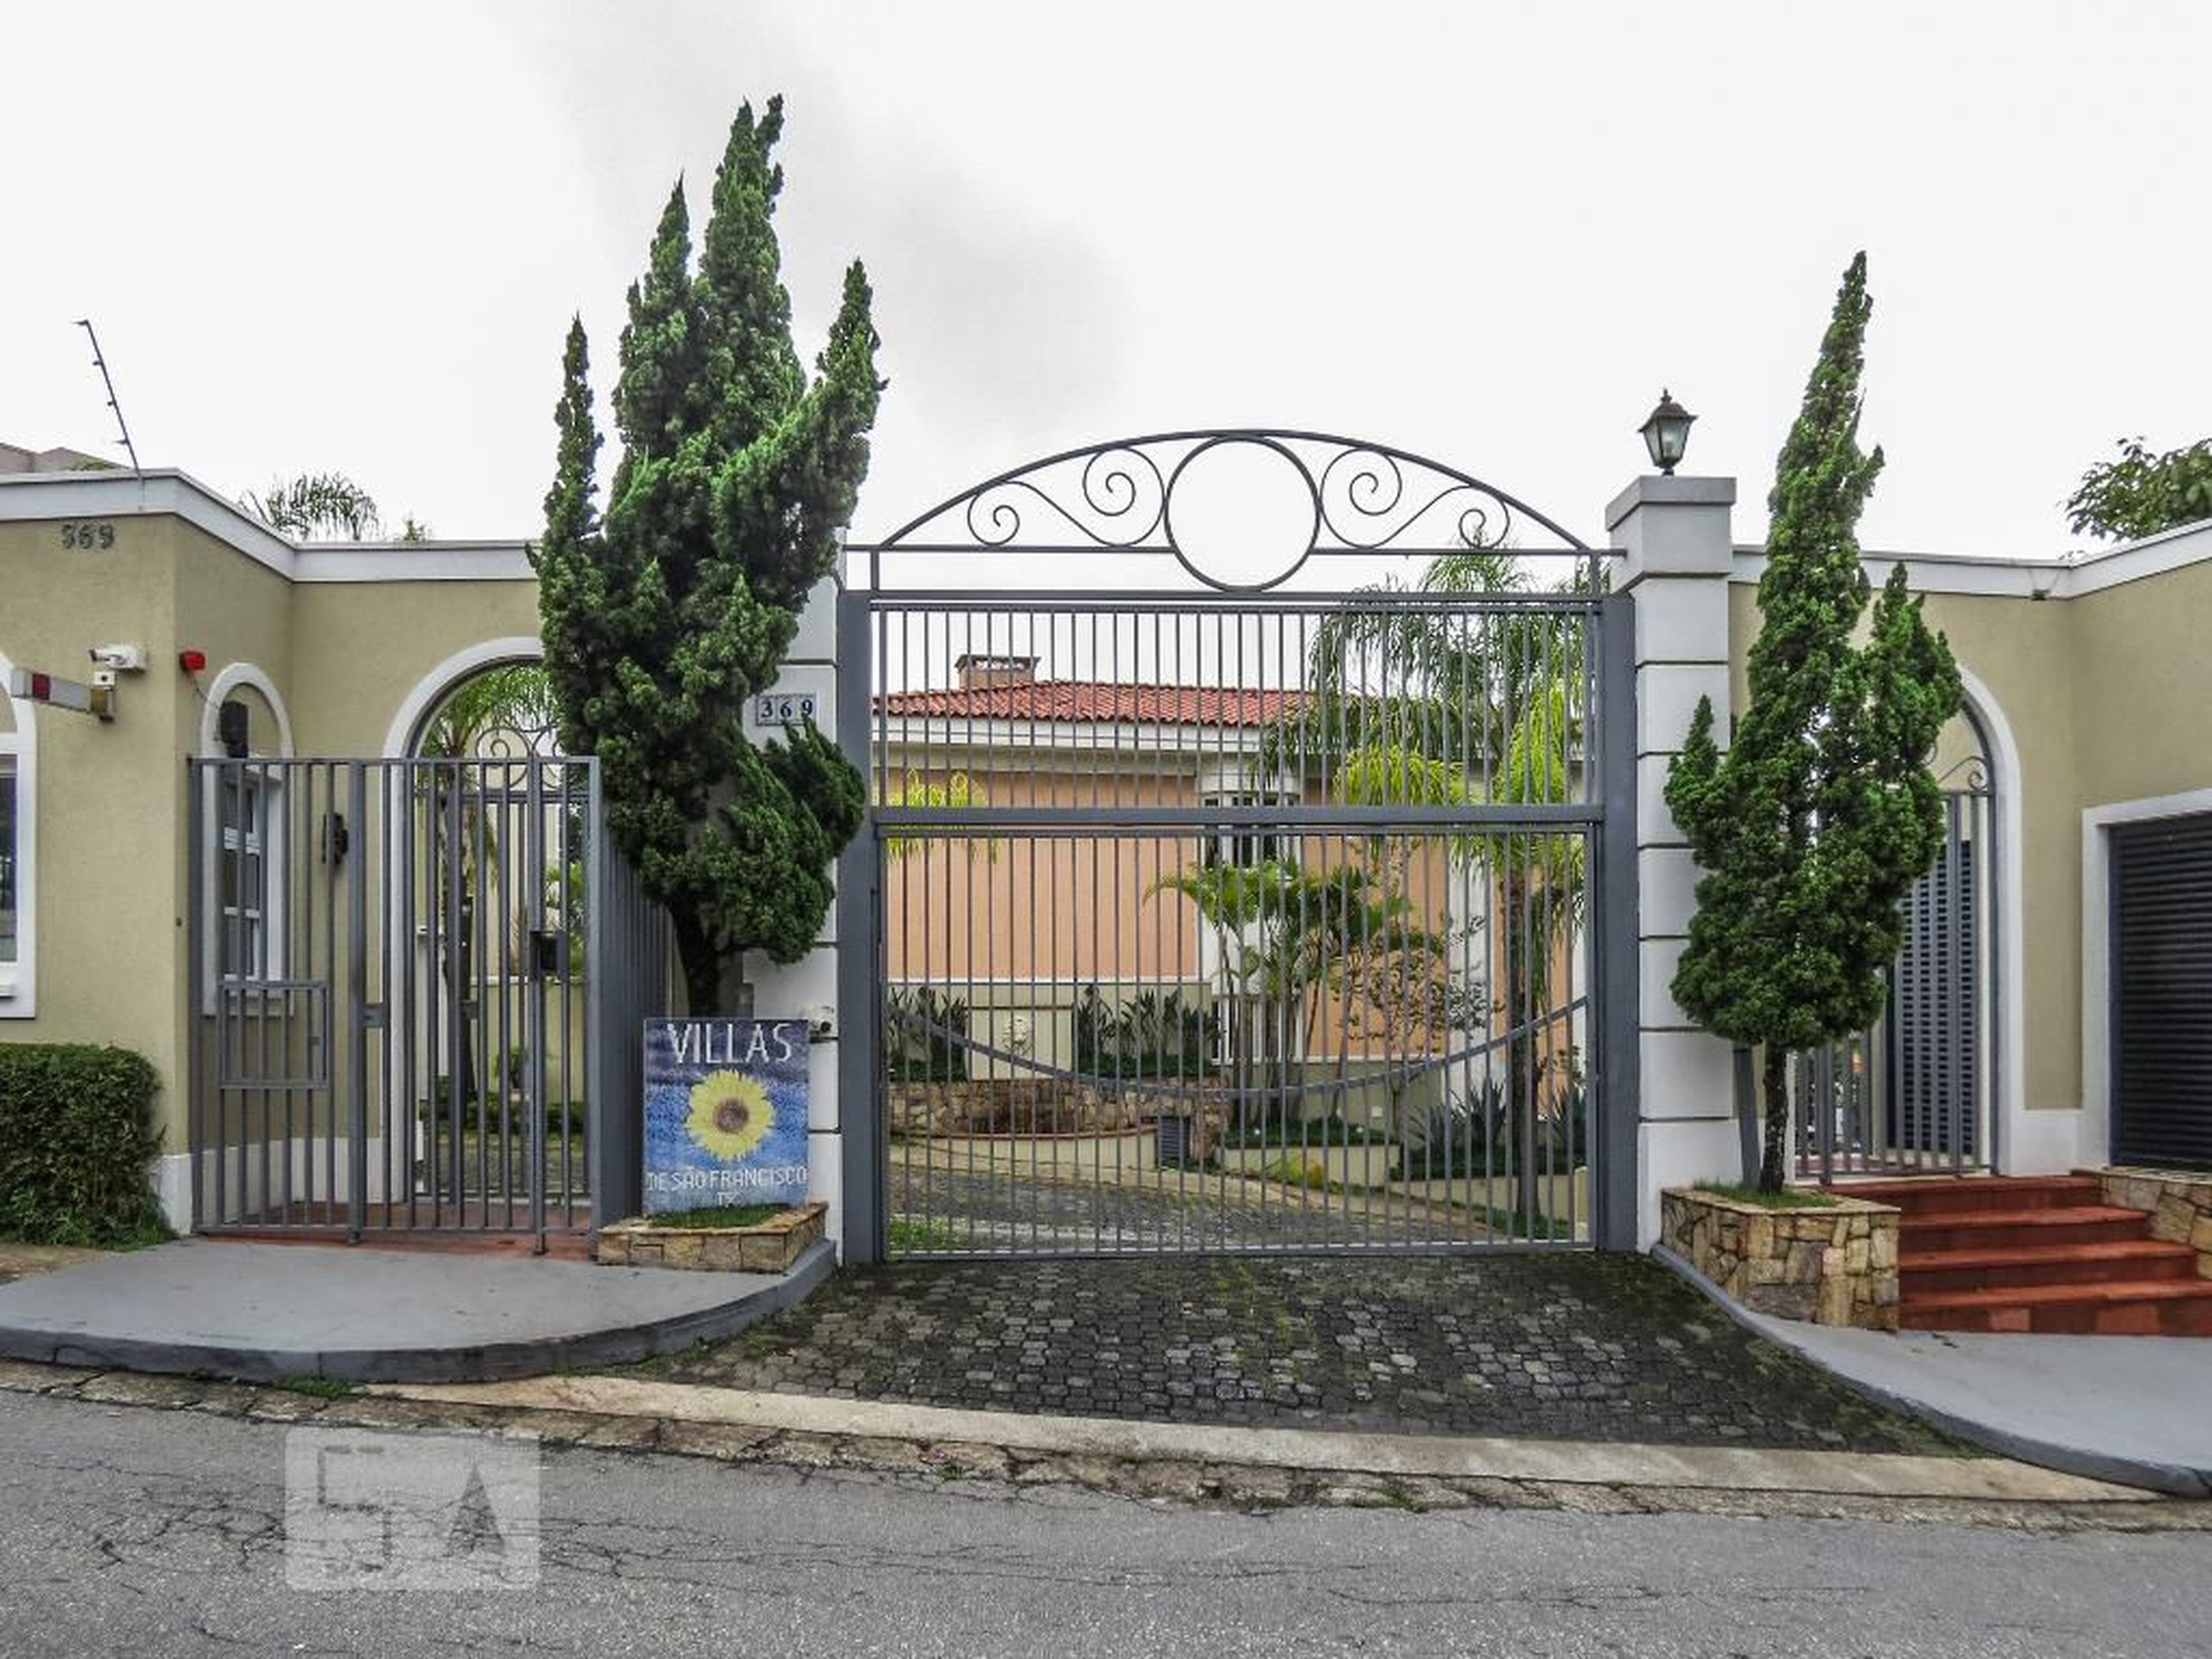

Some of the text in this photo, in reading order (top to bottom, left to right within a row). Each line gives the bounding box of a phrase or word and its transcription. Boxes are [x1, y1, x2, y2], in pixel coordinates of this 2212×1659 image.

[760, 699, 813, 718] 369
[666, 1023, 791, 1063] VILLAS
[710, 1166, 808, 1189] FRANCISCO
